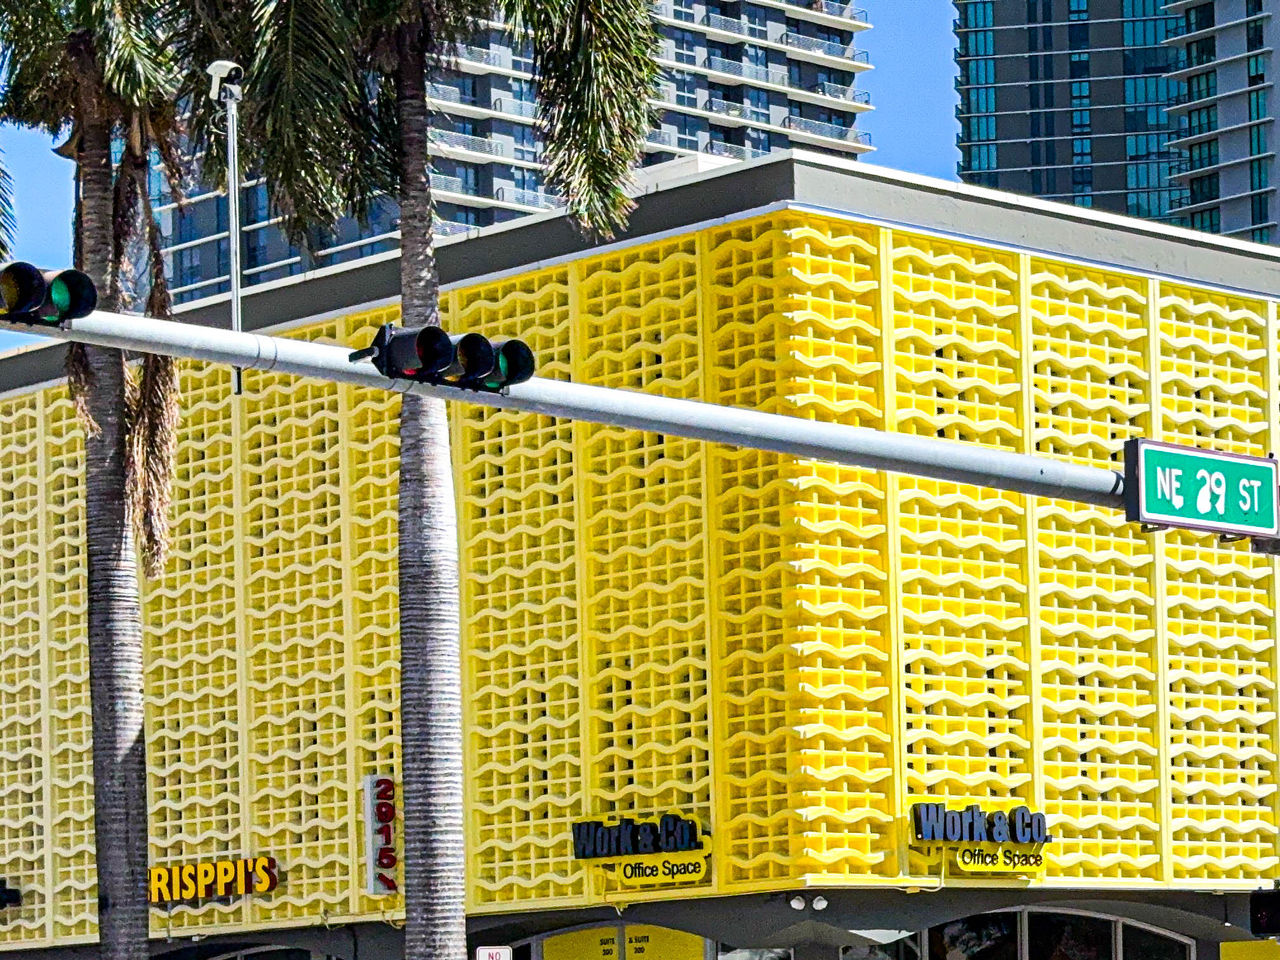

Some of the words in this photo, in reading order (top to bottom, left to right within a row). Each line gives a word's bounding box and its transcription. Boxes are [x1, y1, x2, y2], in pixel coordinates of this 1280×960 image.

[1157, 467, 1184, 510] NE
[1196, 469, 1226, 515] 29
[1238, 478, 1262, 513] ST
[573, 818, 634, 859] Work
[638, 822, 658, 854] &
[660, 814, 703, 852] Co.
[913, 803, 987, 842] Work
[988, 810, 1011, 843] &
[1010, 806, 1052, 843] Co.
[623, 863, 659, 879] Office
[662, 860, 702, 879] Space
[962, 848, 999, 867] Office
[1003, 849, 1043, 870] Space
[148, 857, 276, 902] RISPPI'S
[488, 952, 501, 960] NO
